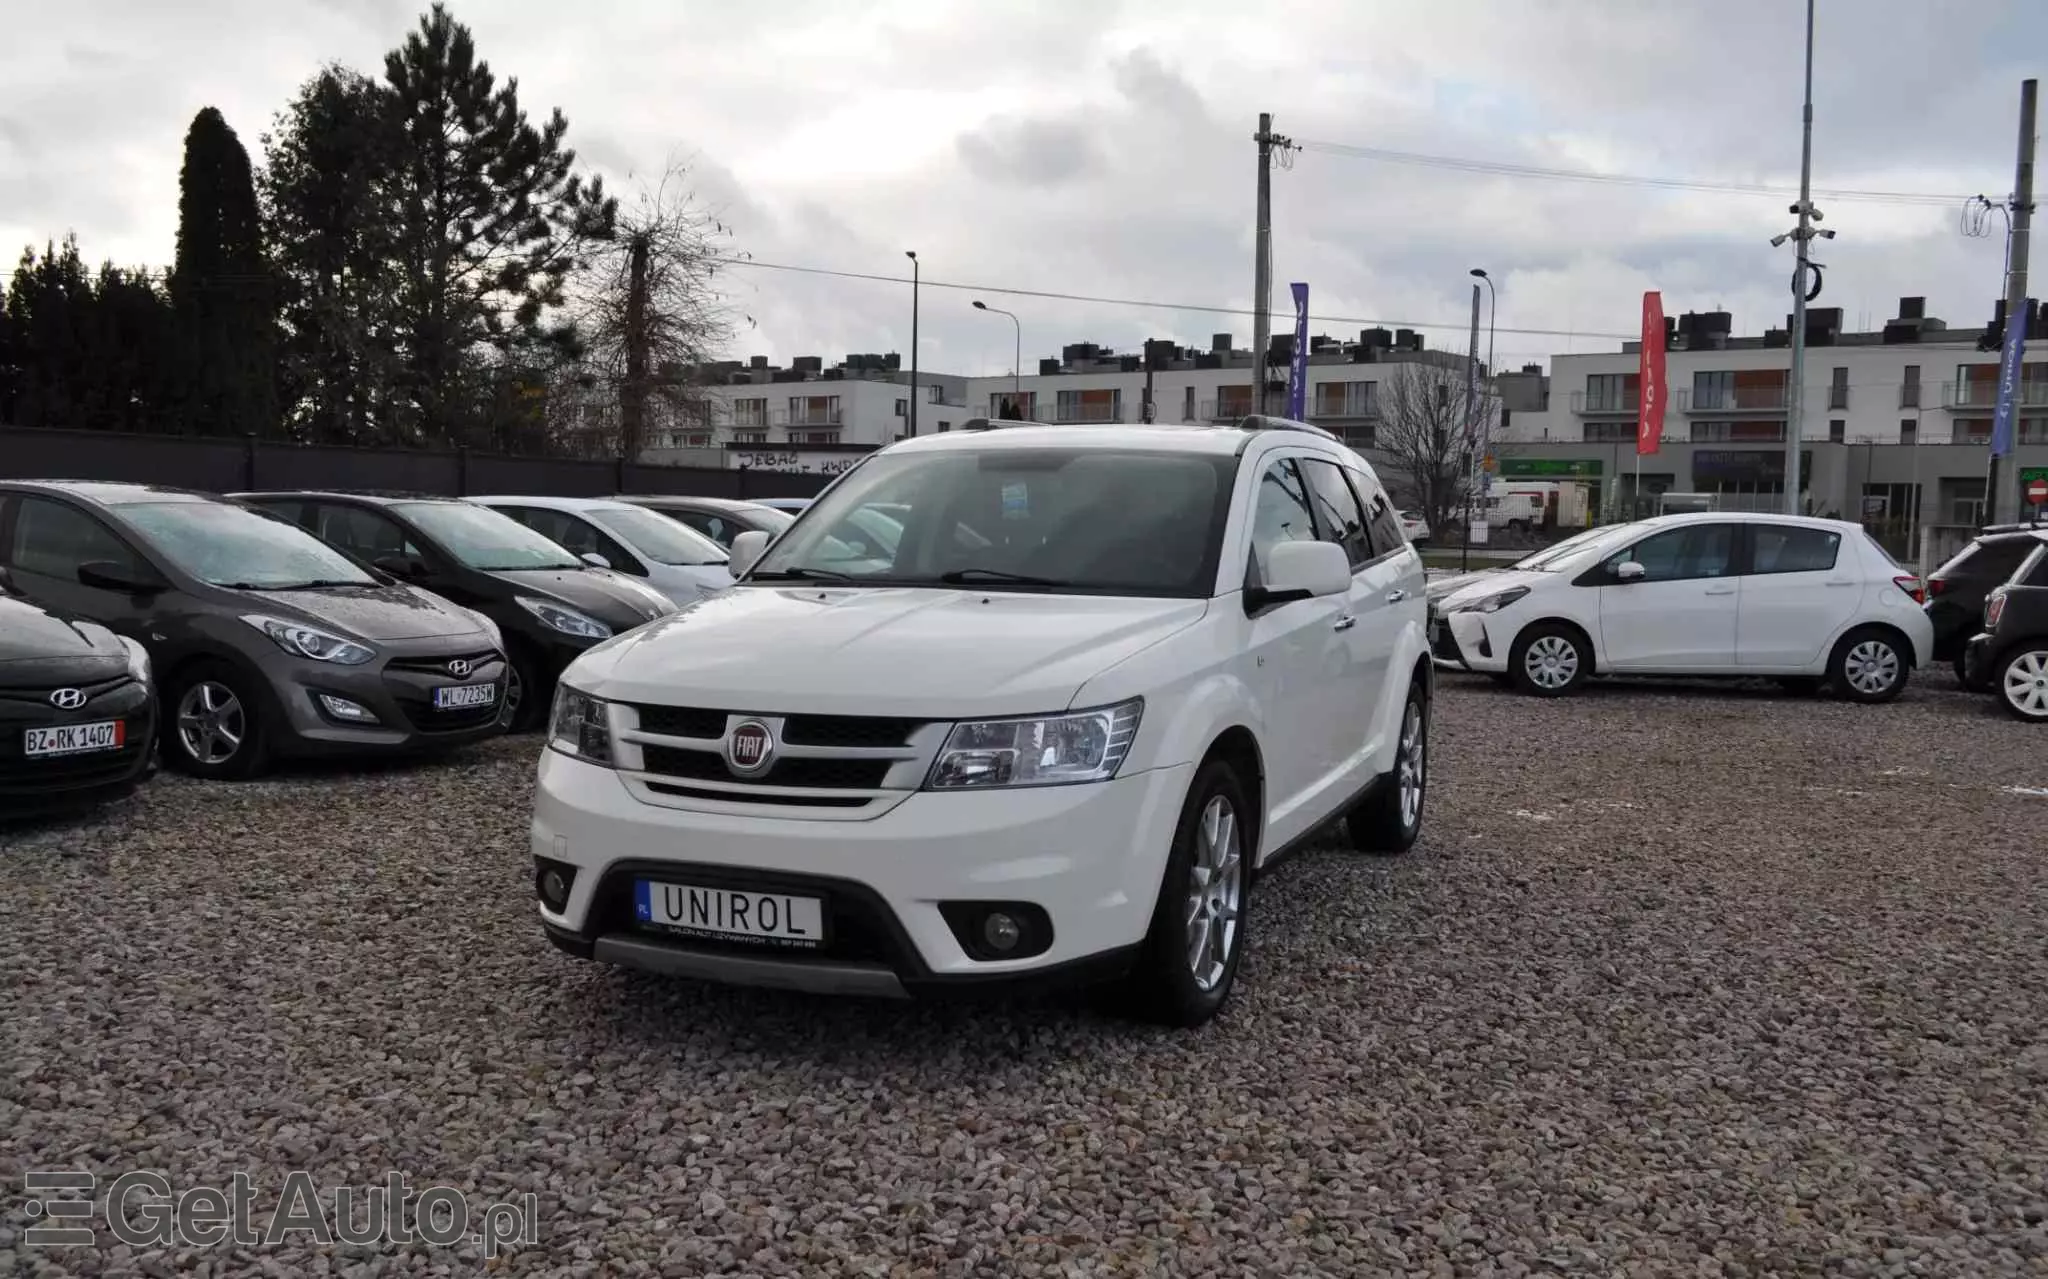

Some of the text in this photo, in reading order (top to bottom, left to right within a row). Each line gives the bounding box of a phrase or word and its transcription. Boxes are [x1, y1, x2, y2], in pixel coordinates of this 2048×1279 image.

[27, 730, 48, 752] BZ
[56, 727, 76, 749] RK
[80, 724, 114, 747] 1407
[736, 735, 763, 757] FIAT
[664, 886, 806, 935] UNIROL
